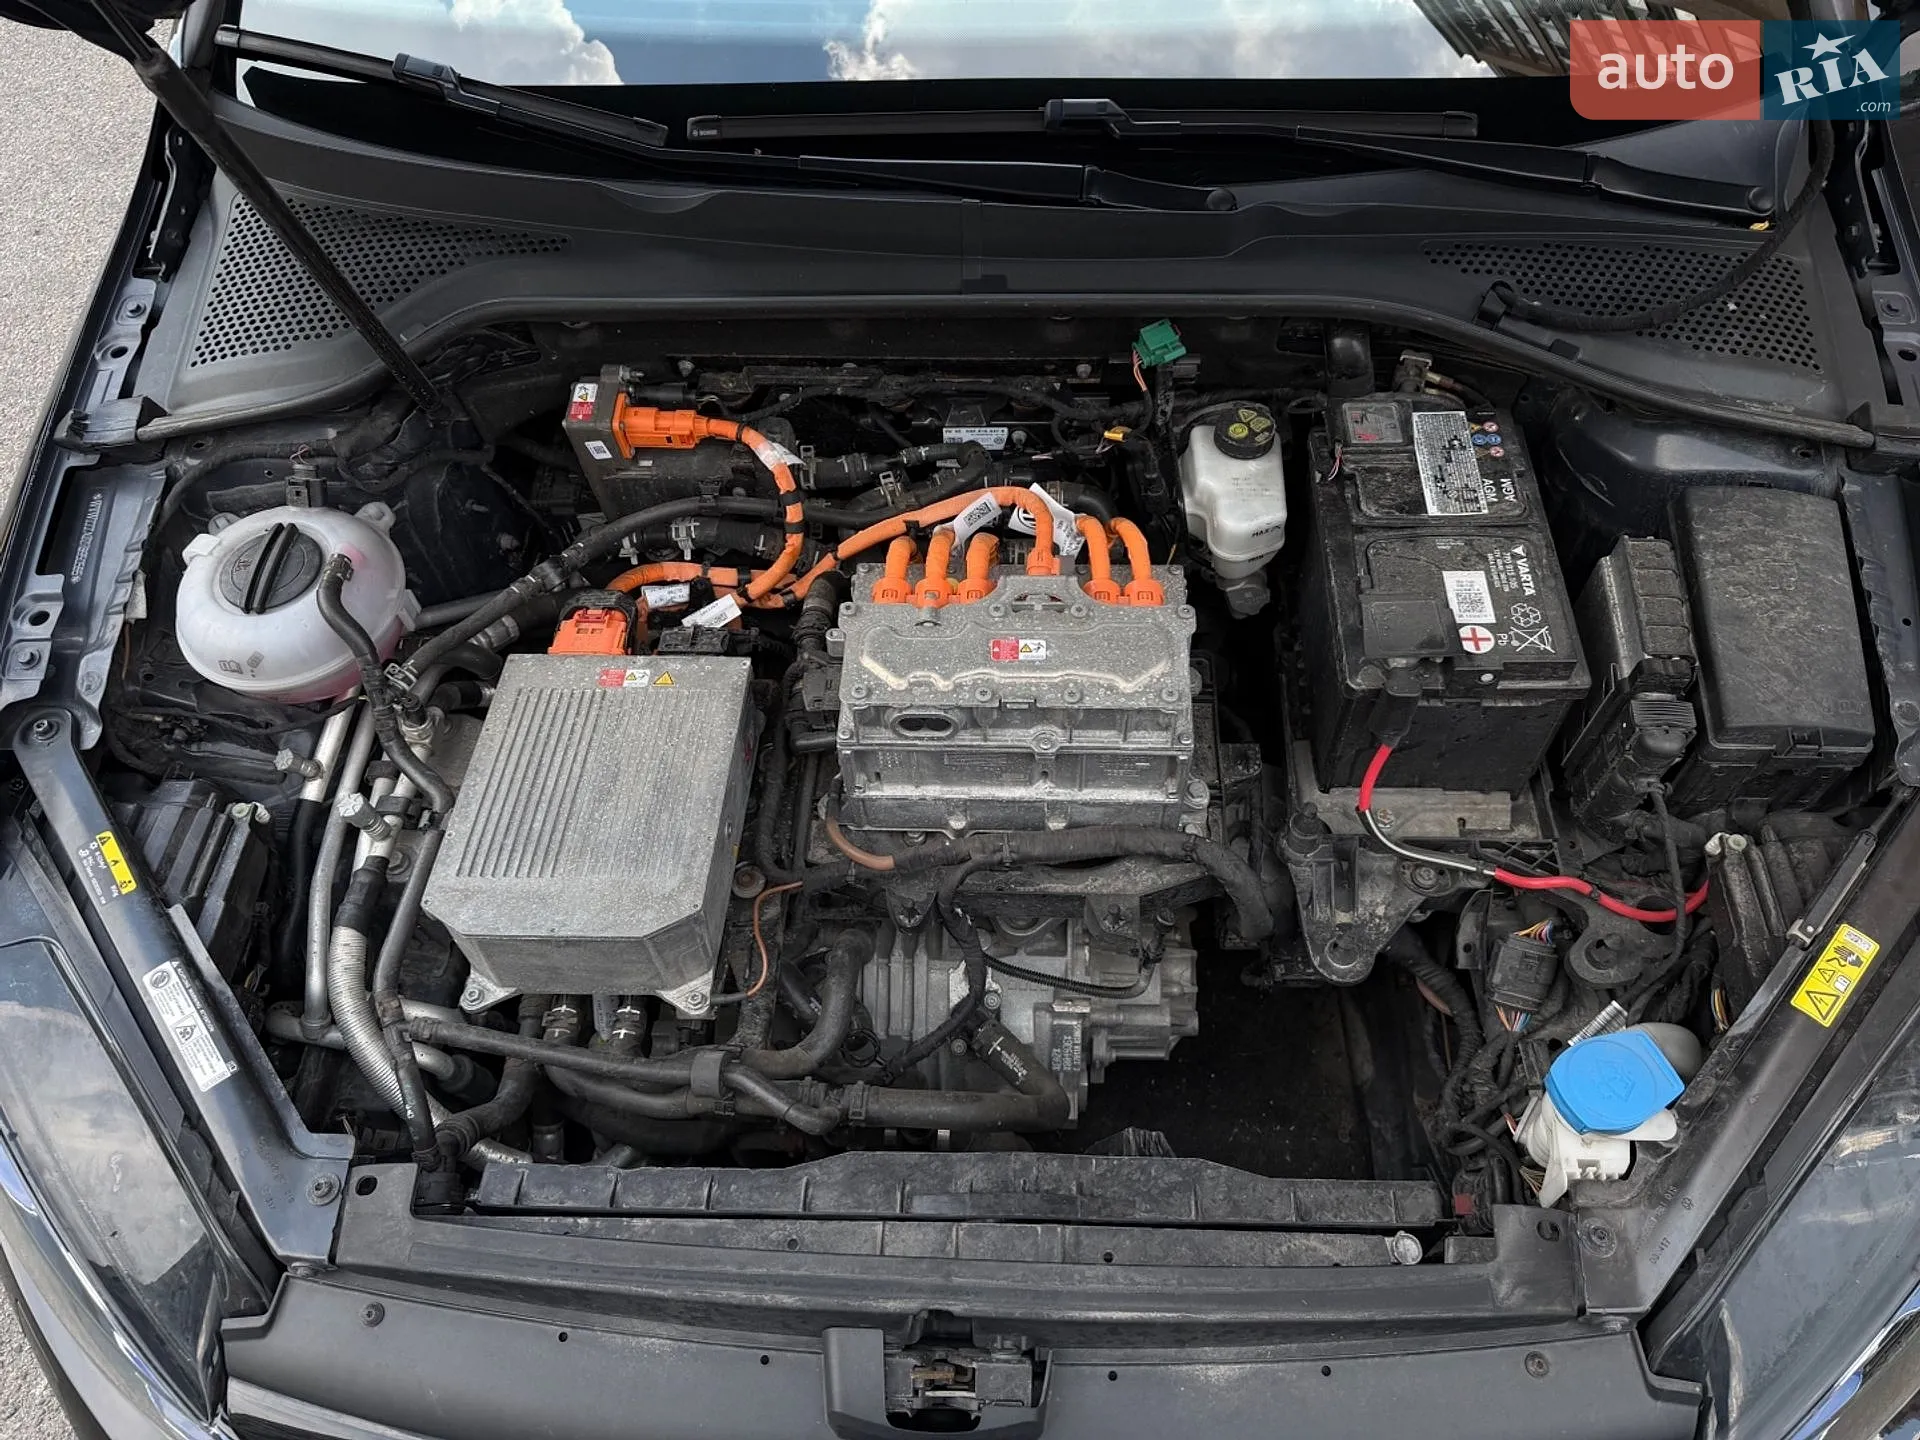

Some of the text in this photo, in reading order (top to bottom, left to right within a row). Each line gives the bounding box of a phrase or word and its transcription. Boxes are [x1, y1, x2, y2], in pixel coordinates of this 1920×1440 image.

[1482, 479, 1498, 502] AGM
[1500, 478, 1516, 502] AGM
[1516, 558, 1536, 596] VARTA
[1496, 633, 1508, 646] Pb
